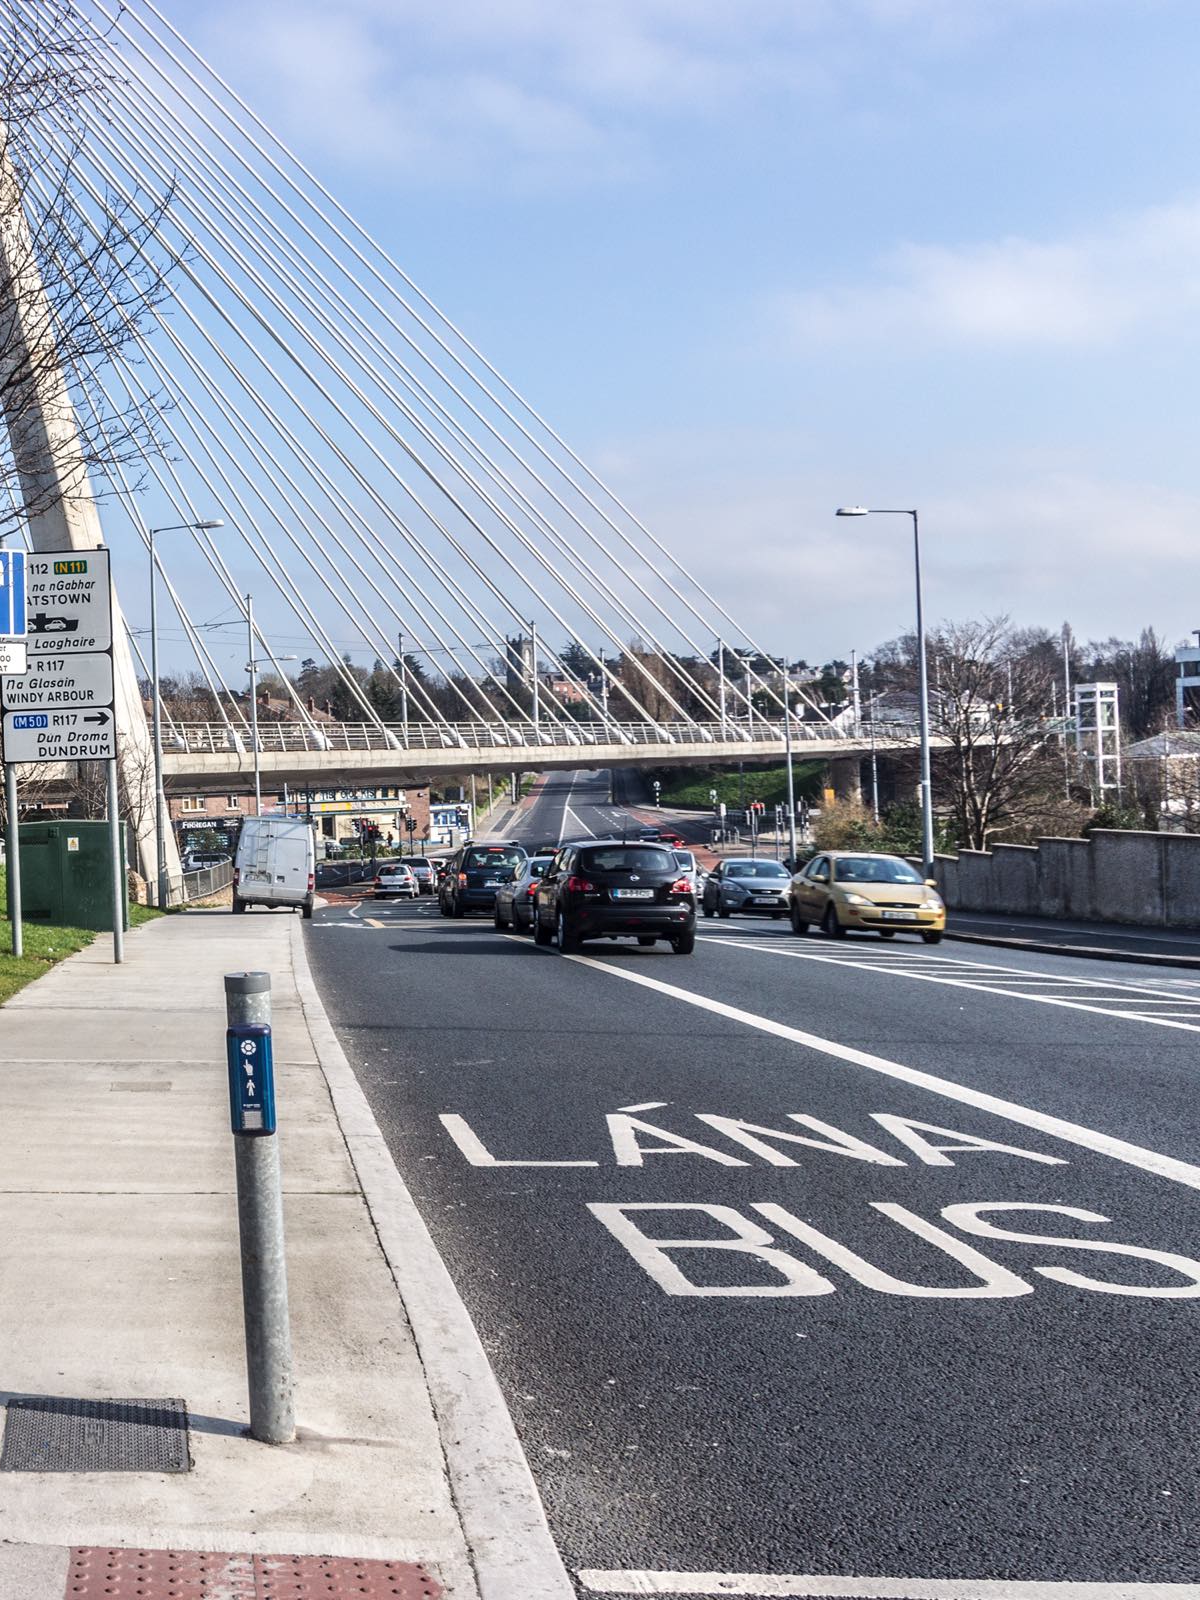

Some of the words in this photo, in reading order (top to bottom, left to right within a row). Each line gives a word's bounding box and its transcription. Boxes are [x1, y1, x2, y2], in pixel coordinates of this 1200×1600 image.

[32, 583, 45, 592] na
[49, 579, 96, 591] nGabhar
[34, 637, 95, 650] Laoghaire
[37, 660, 65, 672] R117
[6, 692, 43, 703] WINDY
[47, 690, 94, 702] ARBOUR
[52, 714, 78, 726] R117
[67, 731, 109, 742] Droma
[38, 745, 110, 757] DUNDRUM
[438, 1101, 1070, 1167] LÁNA
[585, 1202, 1200, 1299] BUS
